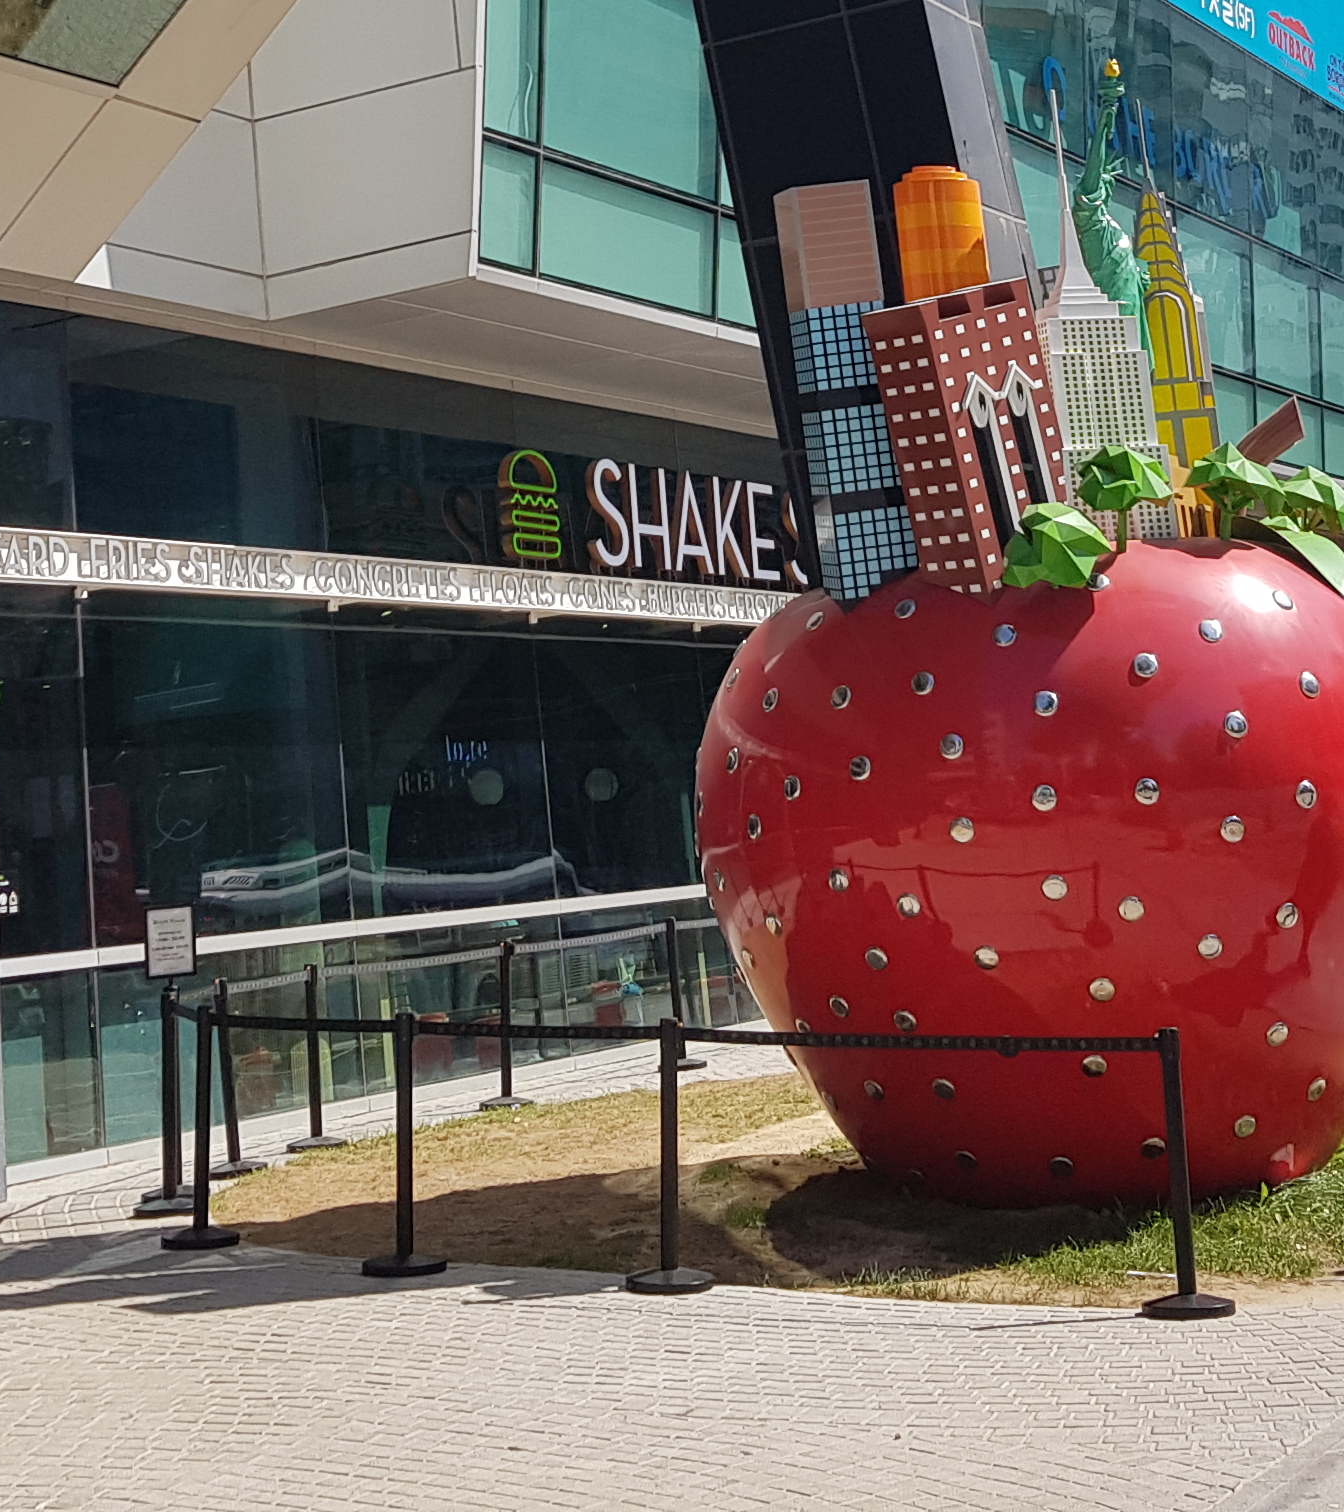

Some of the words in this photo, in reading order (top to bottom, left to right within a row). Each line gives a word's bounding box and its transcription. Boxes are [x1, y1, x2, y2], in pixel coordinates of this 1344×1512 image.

[1268, 22, 1316, 71] OUTBACK
[586, 457, 782, 583] SHAKE
[86, 538, 172, 584] FRIES
[183, 545, 295, 591] SHAKES
[312, 557, 462, 603] CONCRETES
[476, 569, 556, 607] FLOATS
[567, 577, 635, 612] CONES
[646, 583, 727, 619] BURGERS
